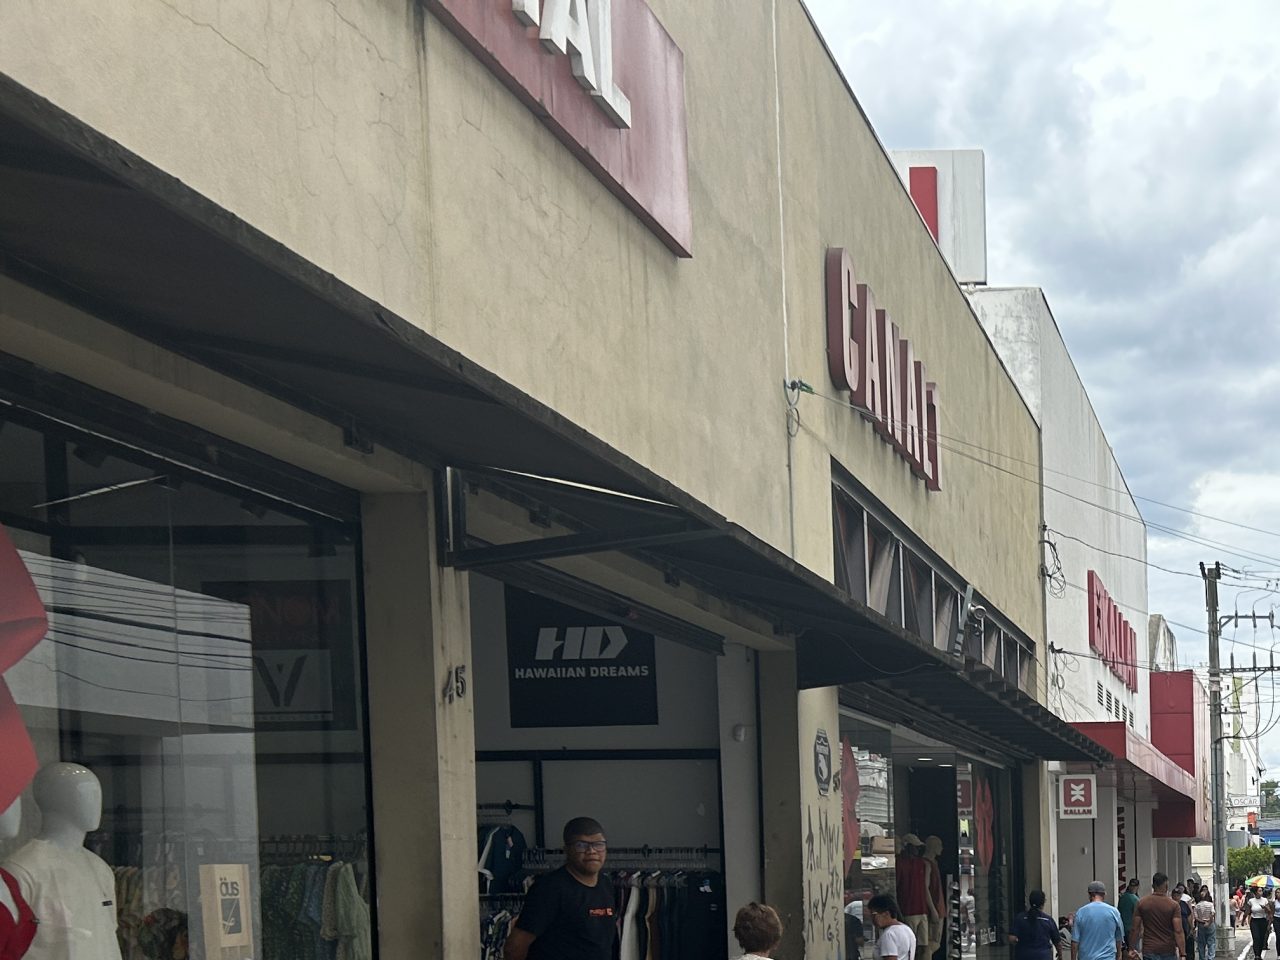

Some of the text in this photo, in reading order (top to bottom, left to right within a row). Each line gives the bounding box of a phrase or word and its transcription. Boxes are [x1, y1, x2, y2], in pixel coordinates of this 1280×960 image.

[515, 665, 649, 680] HAWAIIAN DREAMS
[442, 664, 467, 705] 45
[1063, 808, 1092, 816] KALLAN
